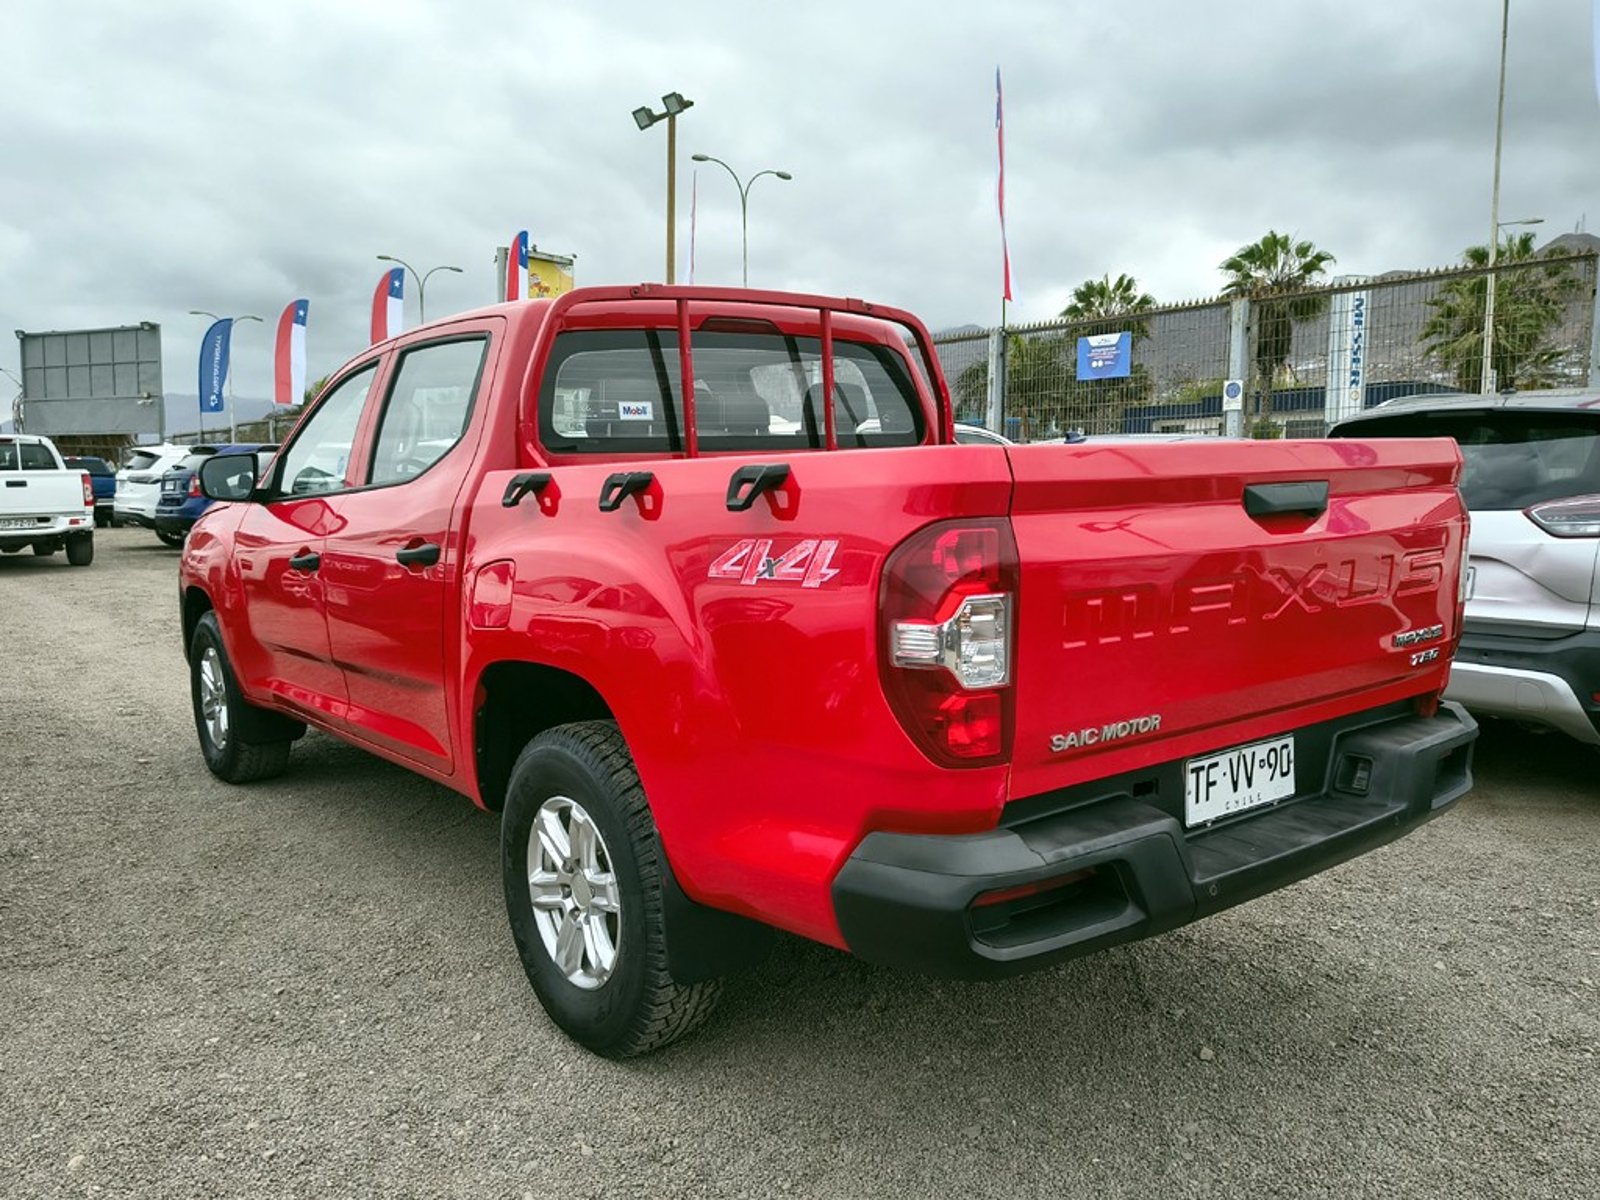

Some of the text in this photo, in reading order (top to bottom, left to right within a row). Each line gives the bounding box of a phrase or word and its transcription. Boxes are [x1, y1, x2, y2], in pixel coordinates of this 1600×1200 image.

[1350, 297, 1364, 388] MESSER
[622, 405, 648, 416] Mobil
[1050, 714, 1162, 752] SAIC MOTOR
